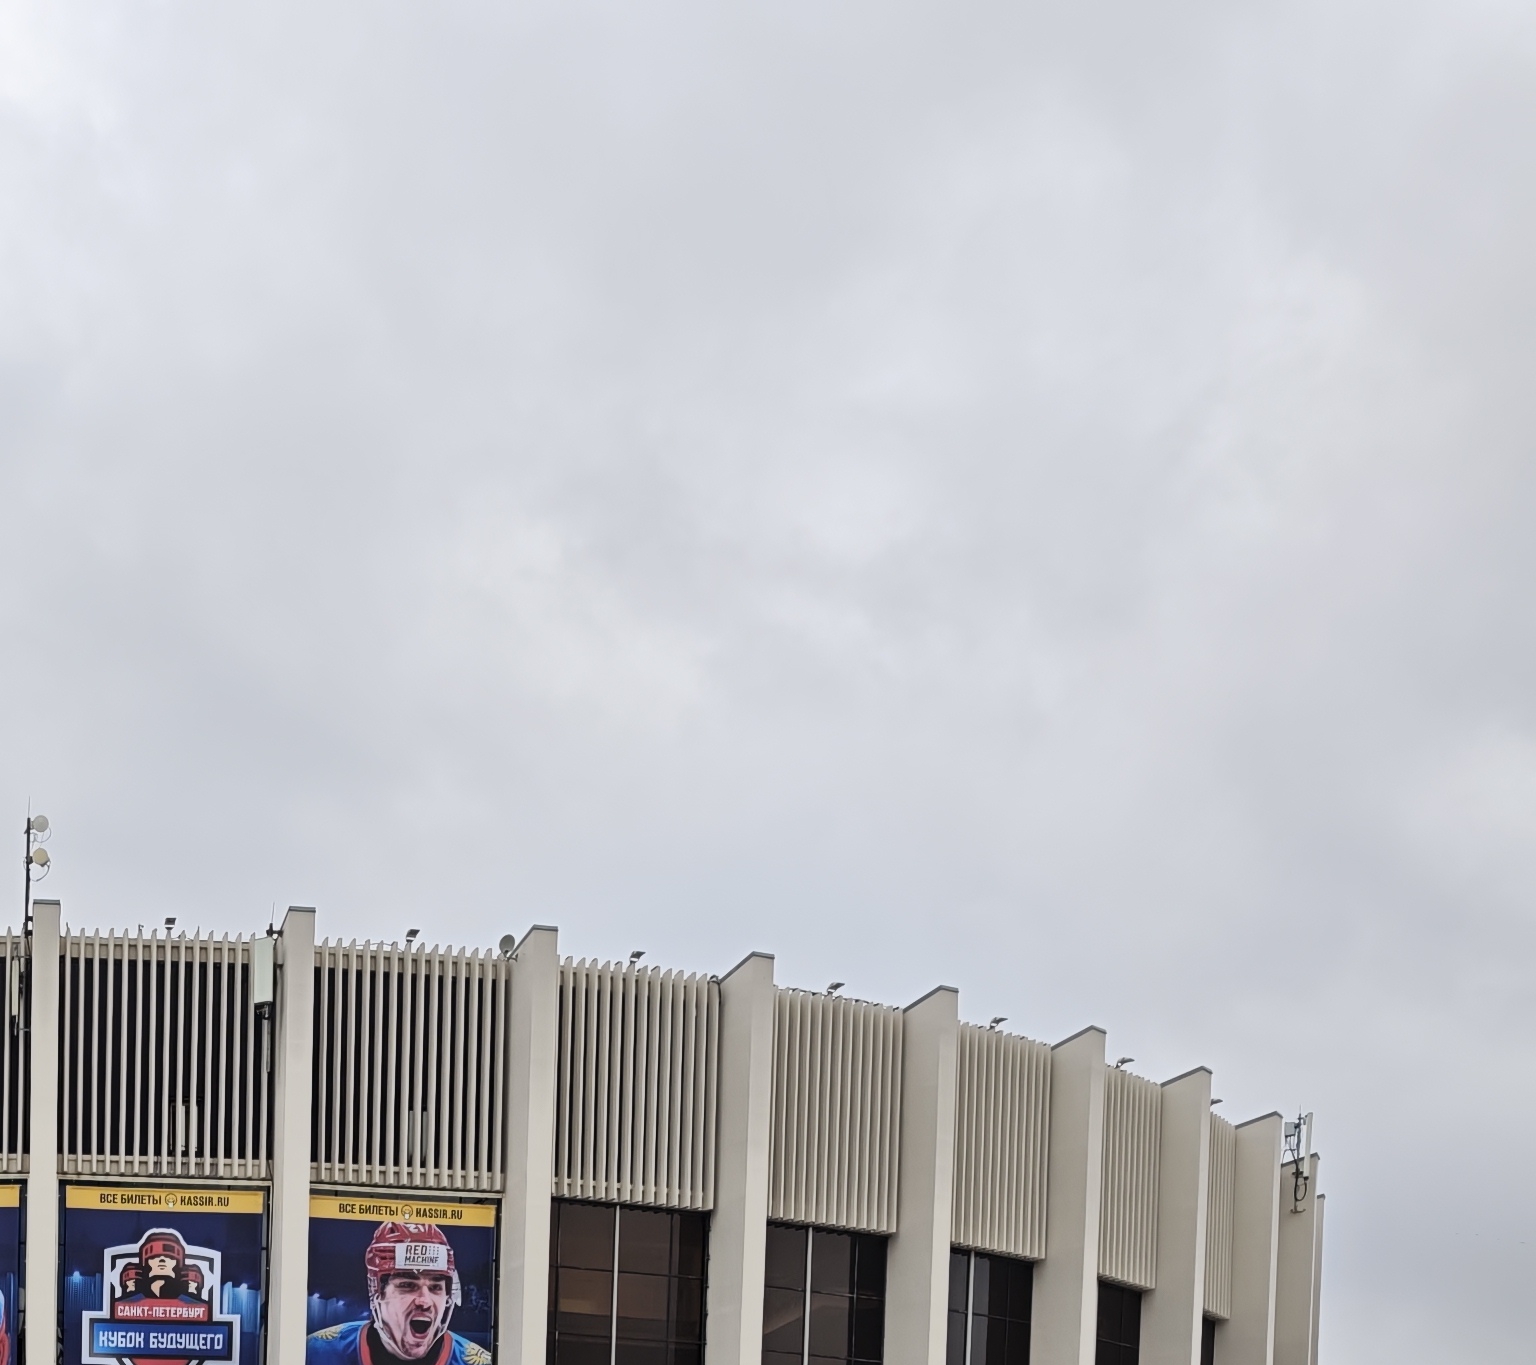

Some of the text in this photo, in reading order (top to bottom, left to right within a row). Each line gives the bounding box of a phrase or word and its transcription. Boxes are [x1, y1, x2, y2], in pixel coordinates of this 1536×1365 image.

[100, 1193, 229, 1207] ВСЕ БИЛЕТЫ KASSIR.RU
[338, 1203, 463, 1220] ВСЕ БИЛЕТЫ KASSIR.RU
[405, 1245, 428, 1256] RED
[117, 1305, 206, 1319] САНКТ-ПЕТЕРБУРГ
[99, 1330, 224, 1351] КУБОК БУДУЩЕГО
